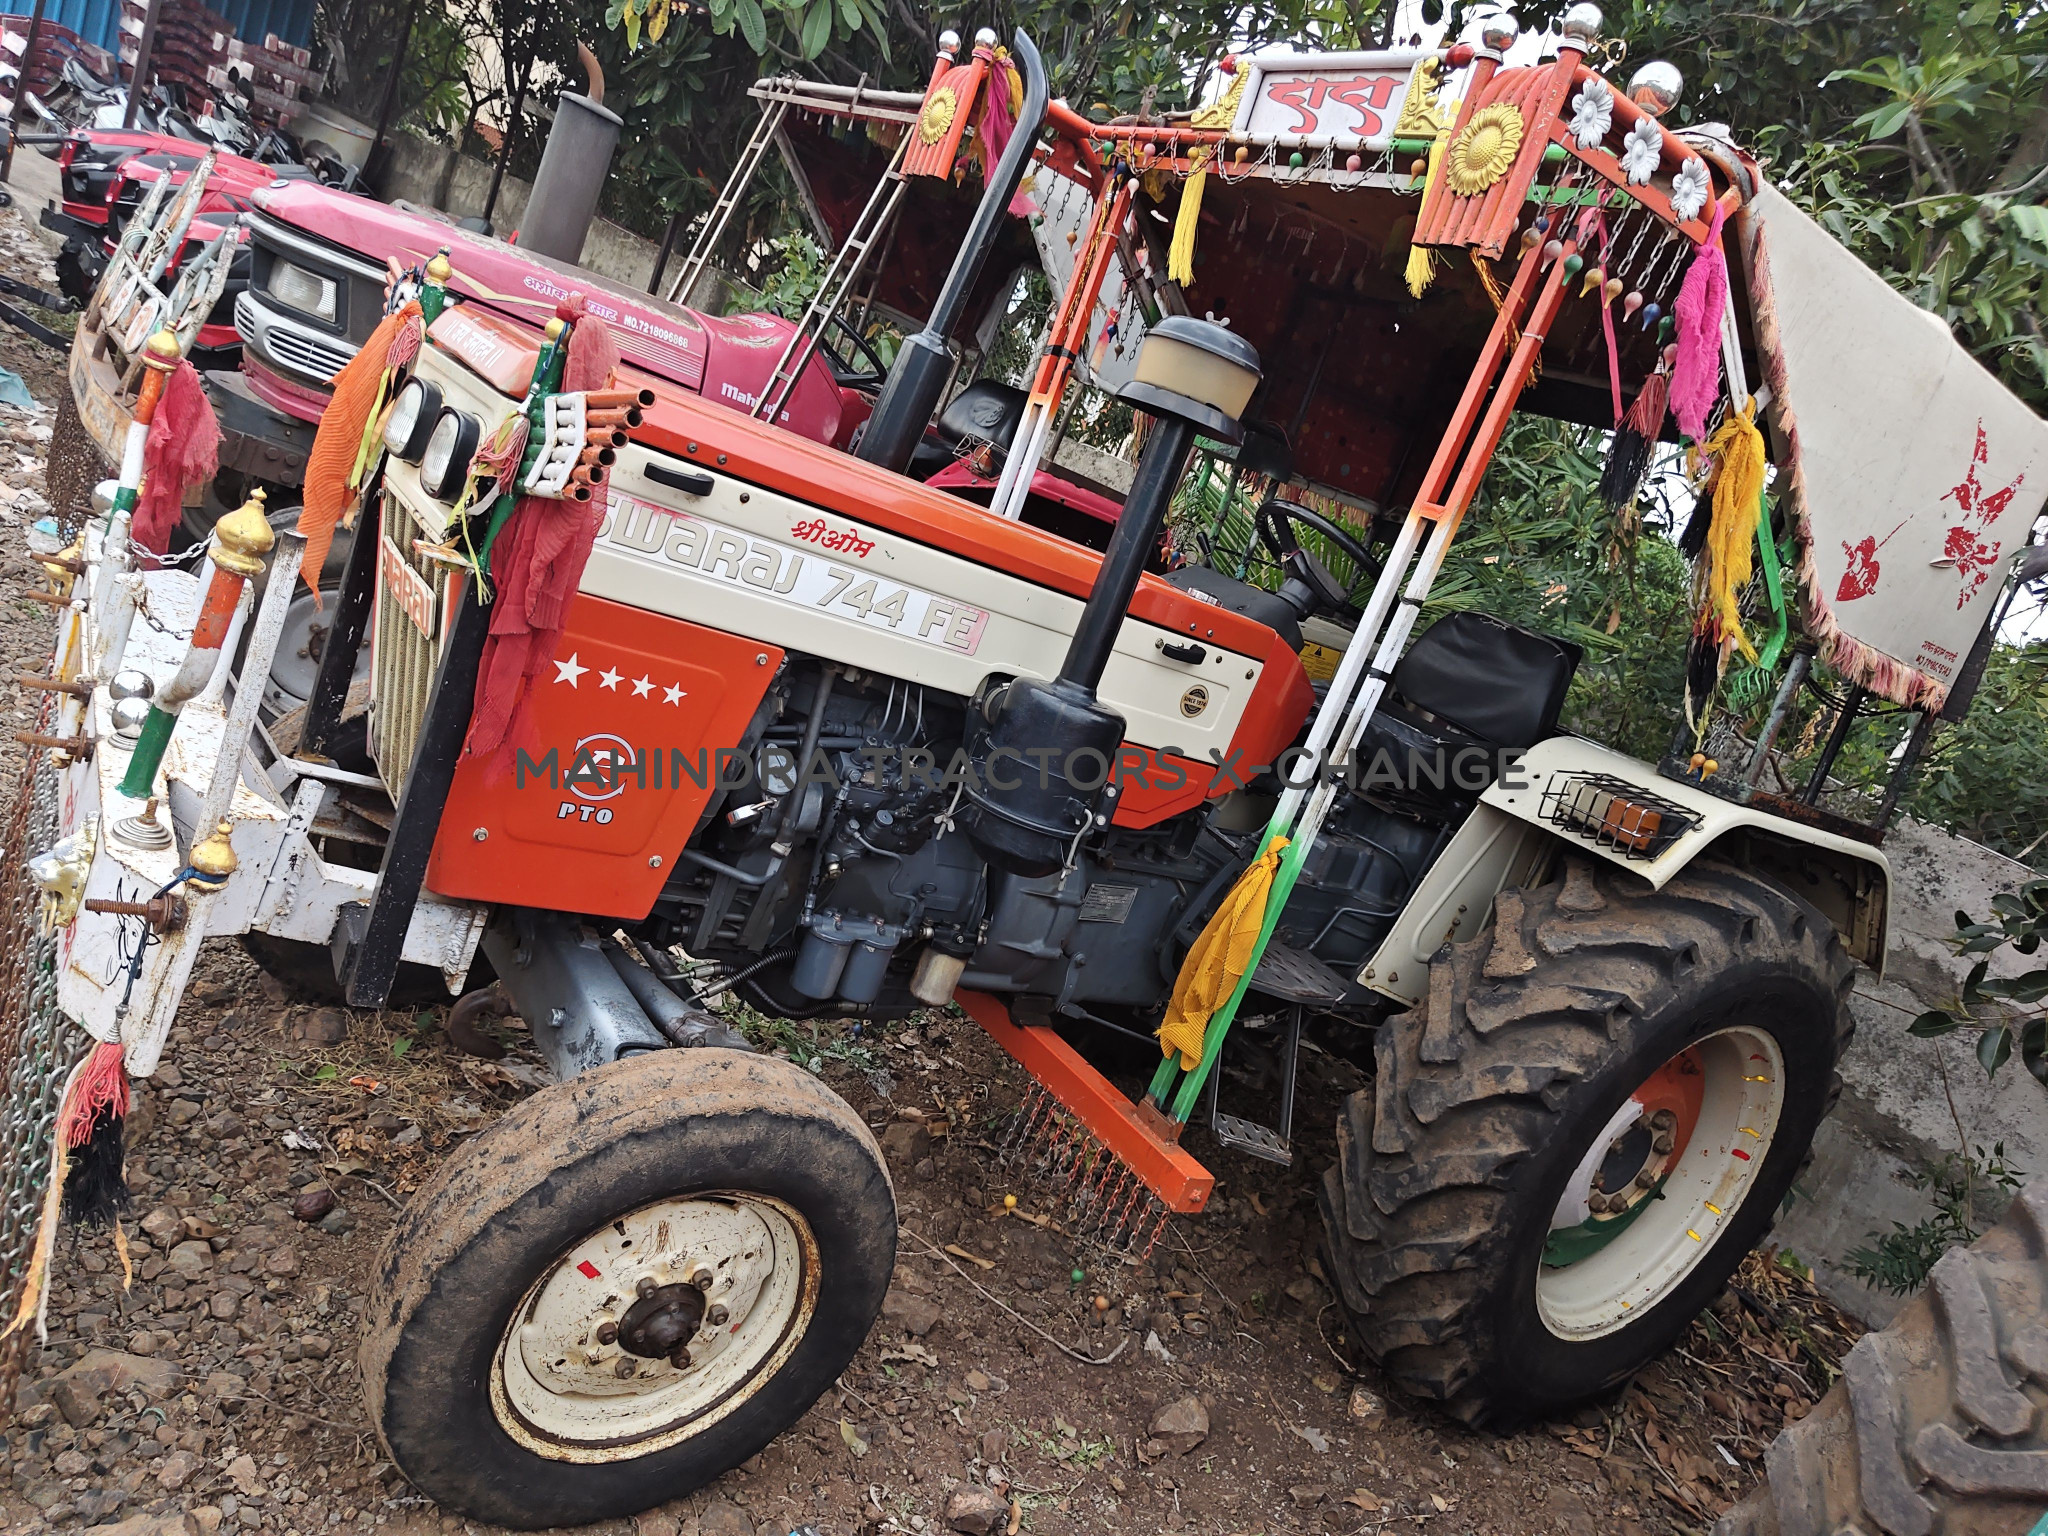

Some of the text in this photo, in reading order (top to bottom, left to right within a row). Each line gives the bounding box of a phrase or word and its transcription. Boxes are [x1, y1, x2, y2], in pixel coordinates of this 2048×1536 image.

[523, 275, 569, 301] अशोक
[817, 567, 909, 627] 744
[918, 599, 979, 650] FE
[557, 802, 614, 825] PTO
